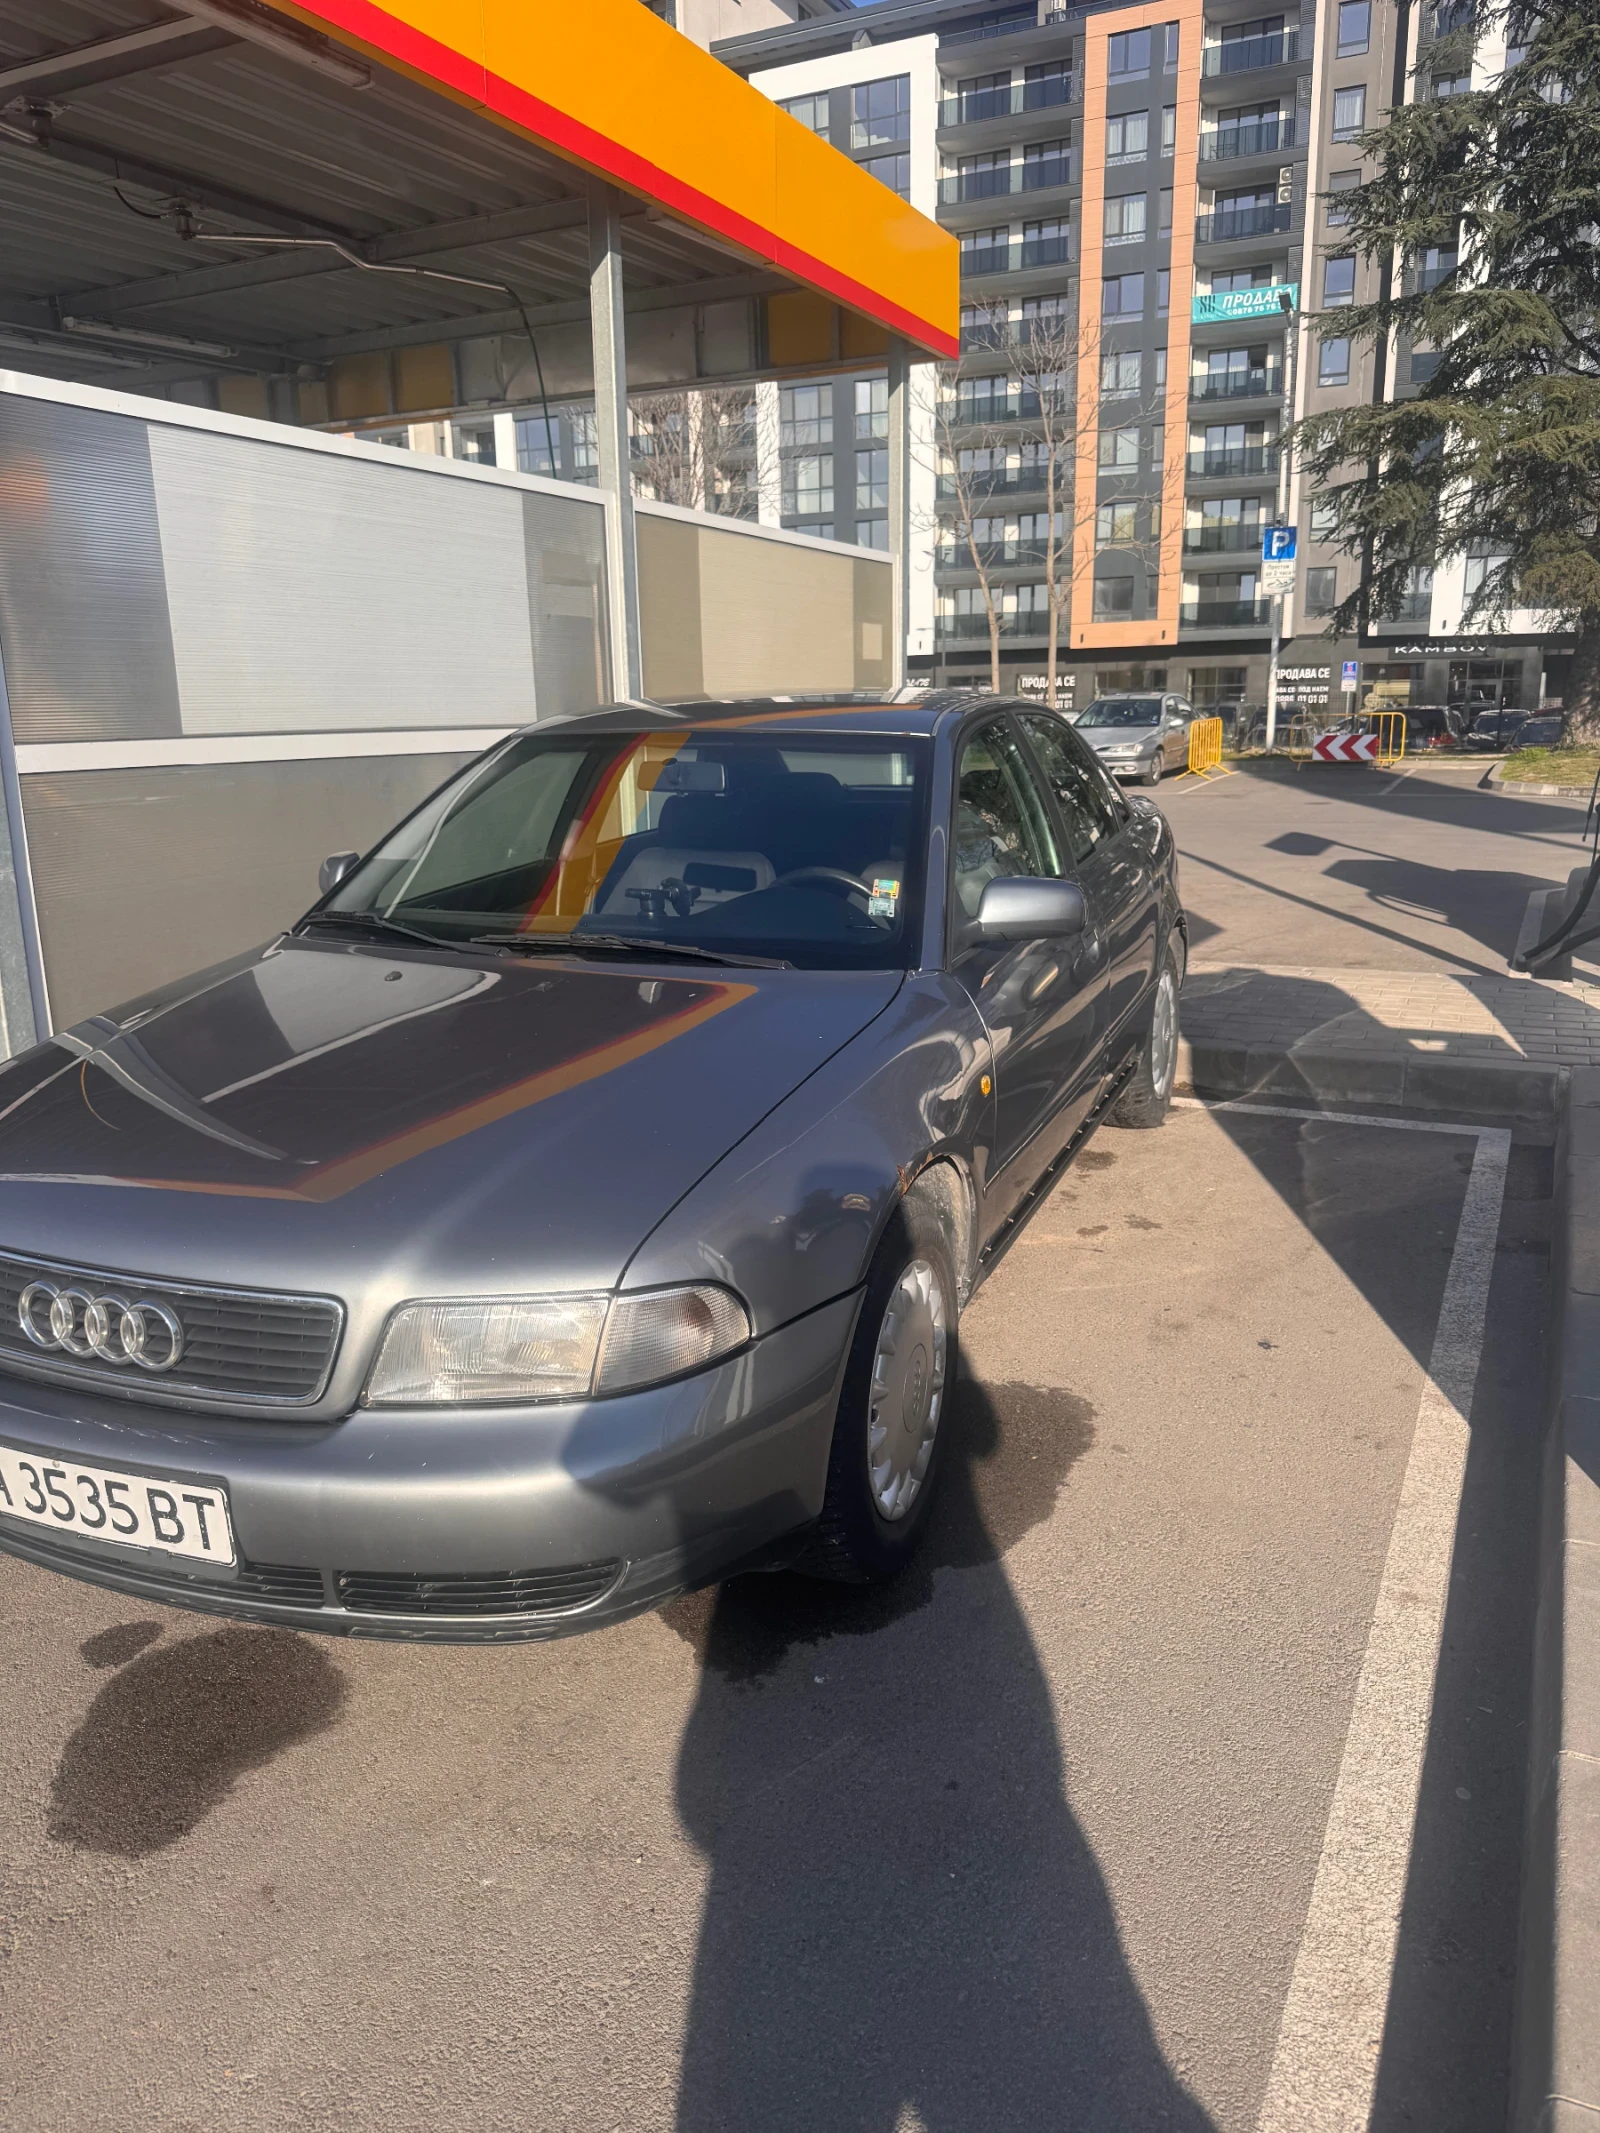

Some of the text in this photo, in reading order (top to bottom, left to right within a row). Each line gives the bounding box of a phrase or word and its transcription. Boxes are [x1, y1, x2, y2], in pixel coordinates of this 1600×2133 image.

[1272, 531, 1290, 557] P
[1064, 675, 1076, 687] СЕ
[1317, 667, 1331, 679] СЕ
[19, 1461, 139, 1535] 3535
[146, 1487, 215, 1550] BT
